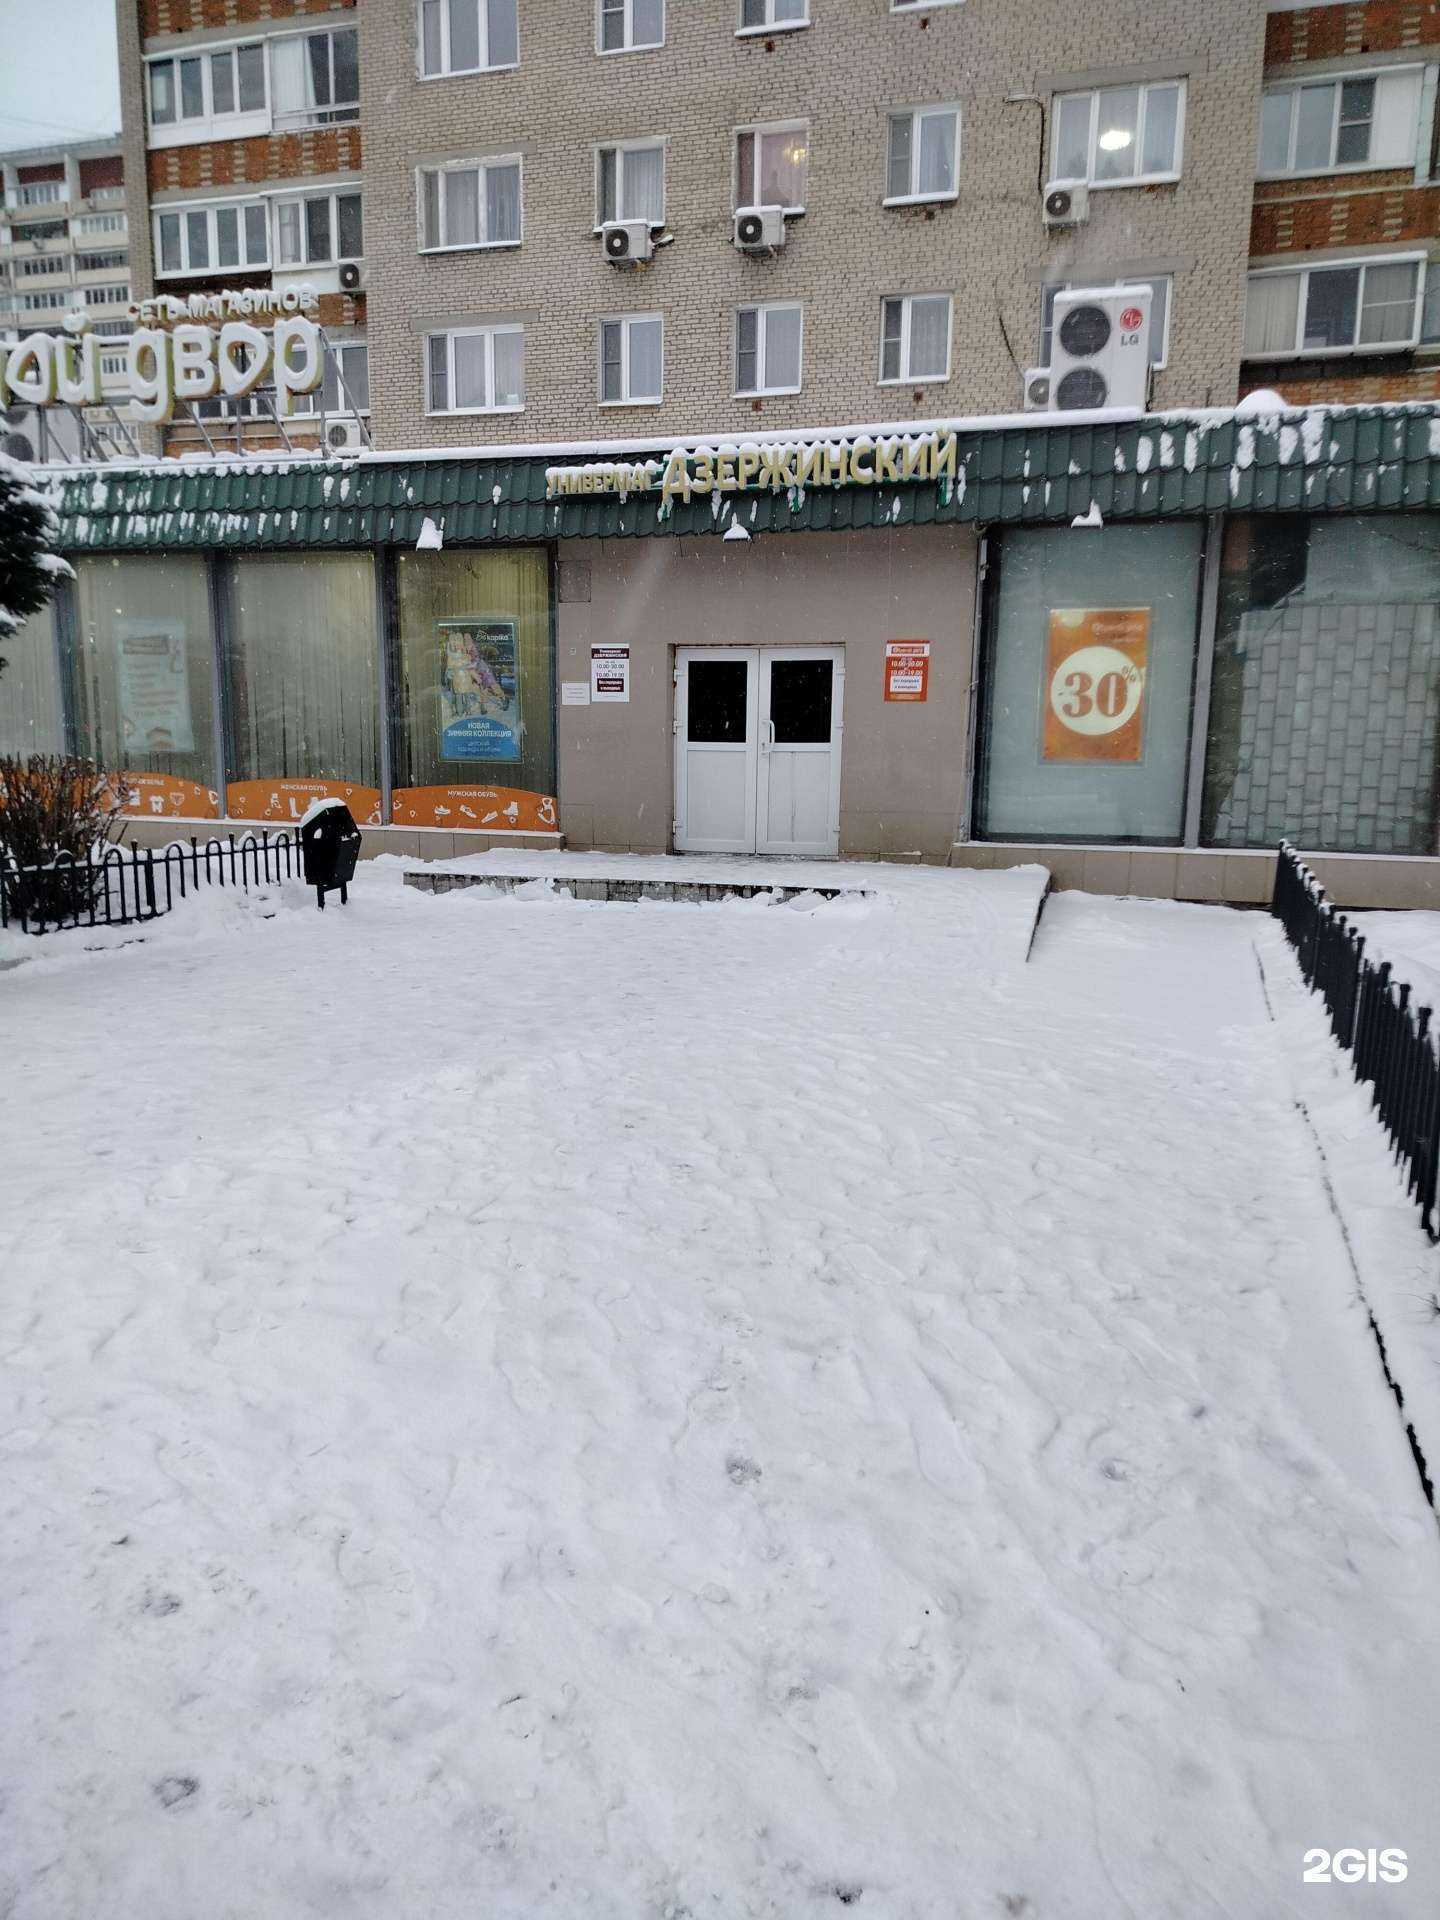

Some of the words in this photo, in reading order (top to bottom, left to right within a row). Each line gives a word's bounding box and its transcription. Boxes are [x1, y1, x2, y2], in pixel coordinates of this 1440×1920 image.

[127, 296, 187, 321] СЕТЬ
[188, 284, 319, 319] МАГАЗИНОВ
[0, 312, 101, 412] ой
[1120, 334, 1139, 347] LG
[545, 464, 656, 499] УНИВЕРМАГ
[661, 428, 957, 505] ДЗЕРЖИНСКИЙ
